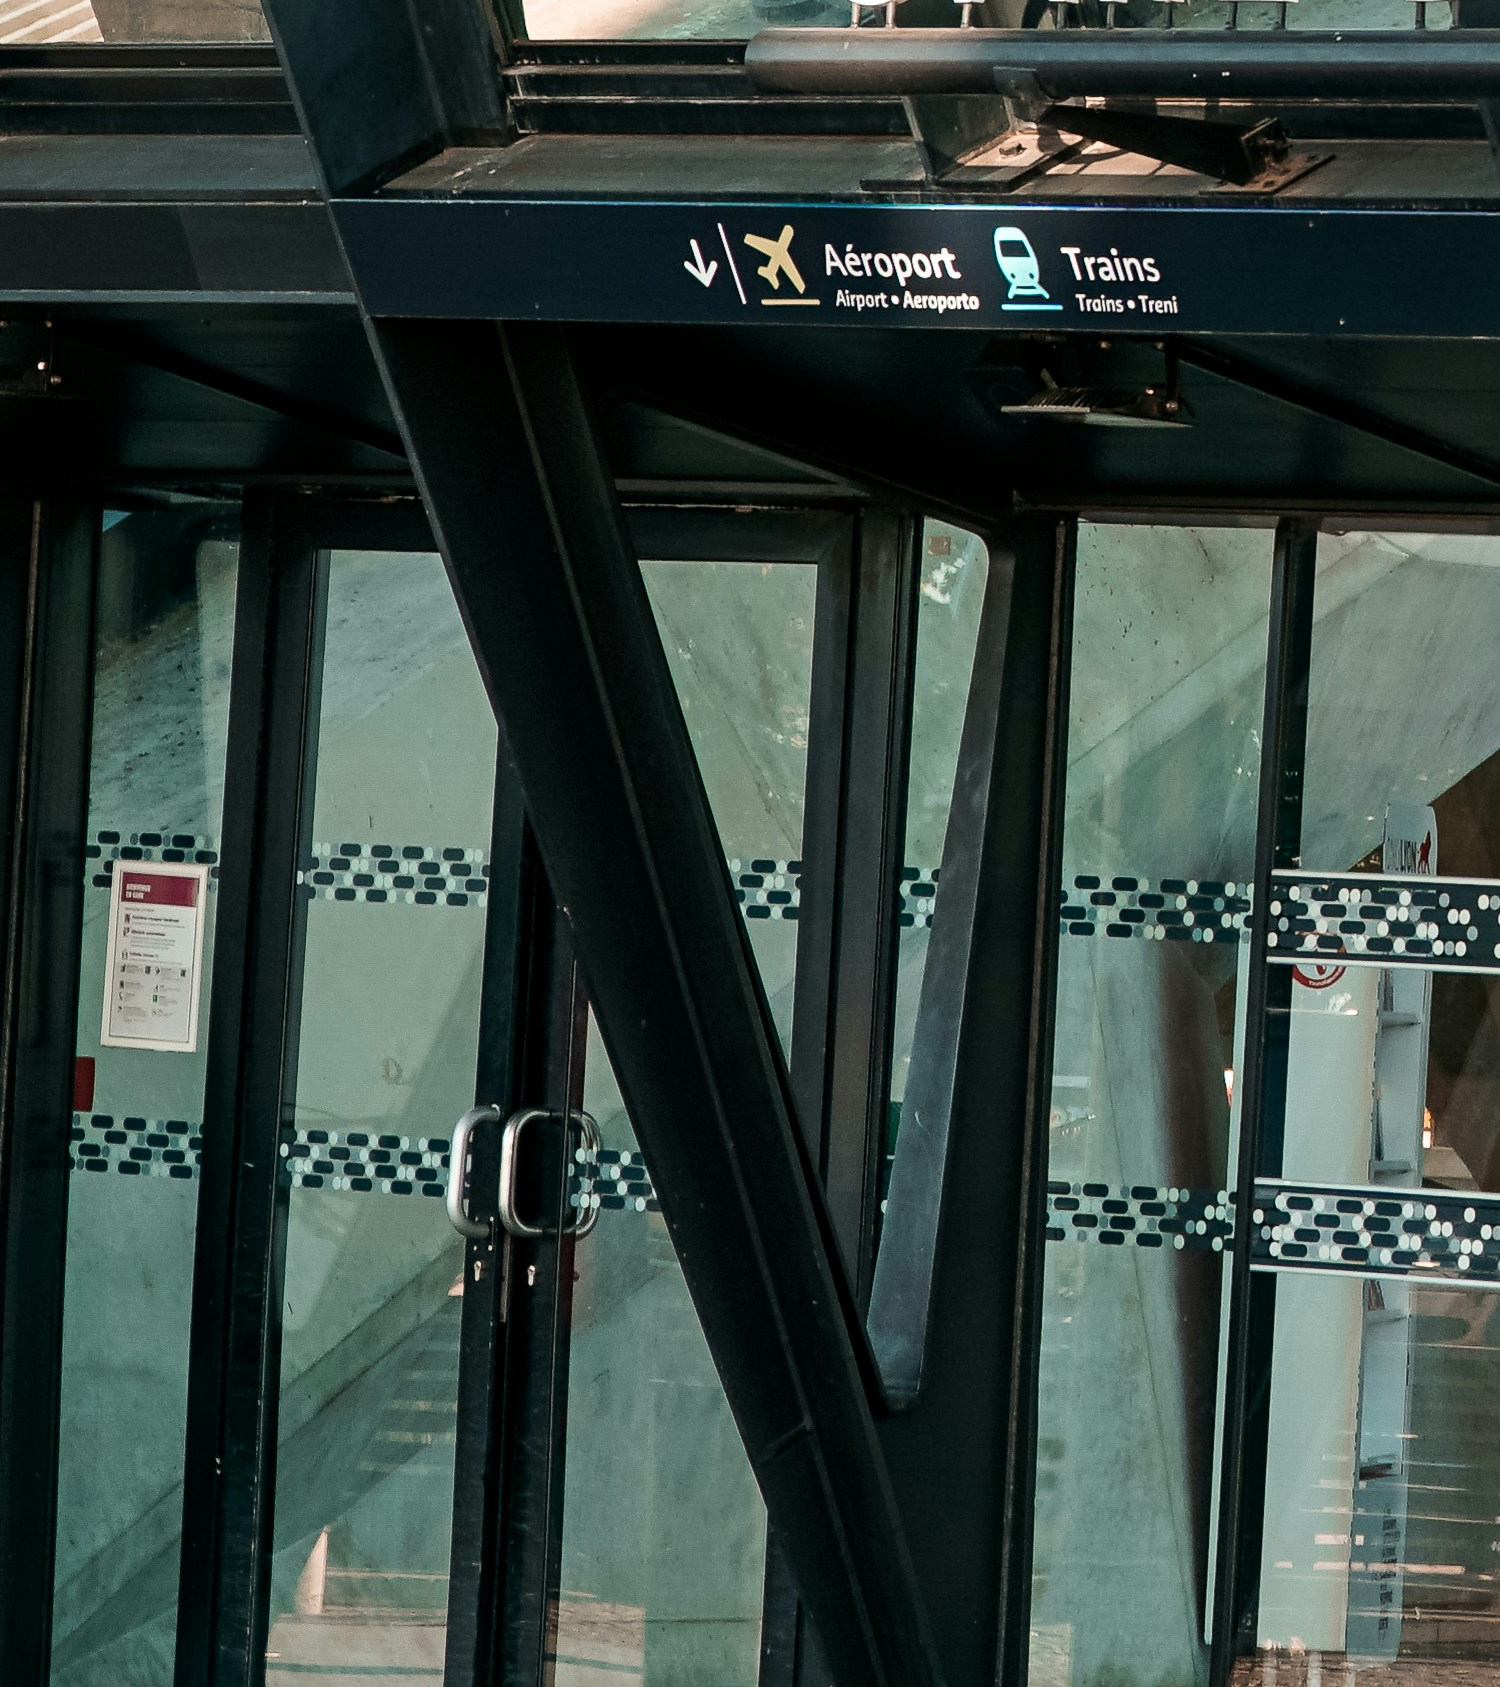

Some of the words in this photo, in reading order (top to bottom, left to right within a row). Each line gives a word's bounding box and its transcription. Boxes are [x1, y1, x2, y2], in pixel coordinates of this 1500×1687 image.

[824, 243, 961, 286] Aéroport
[1061, 246, 1161, 282] Trains
[835, 289, 889, 311] Airport
[903, 291, 980, 313] Aeroporto
[1075, 293, 1124, 313] Trains
[1139, 295, 1178, 314] Treni
